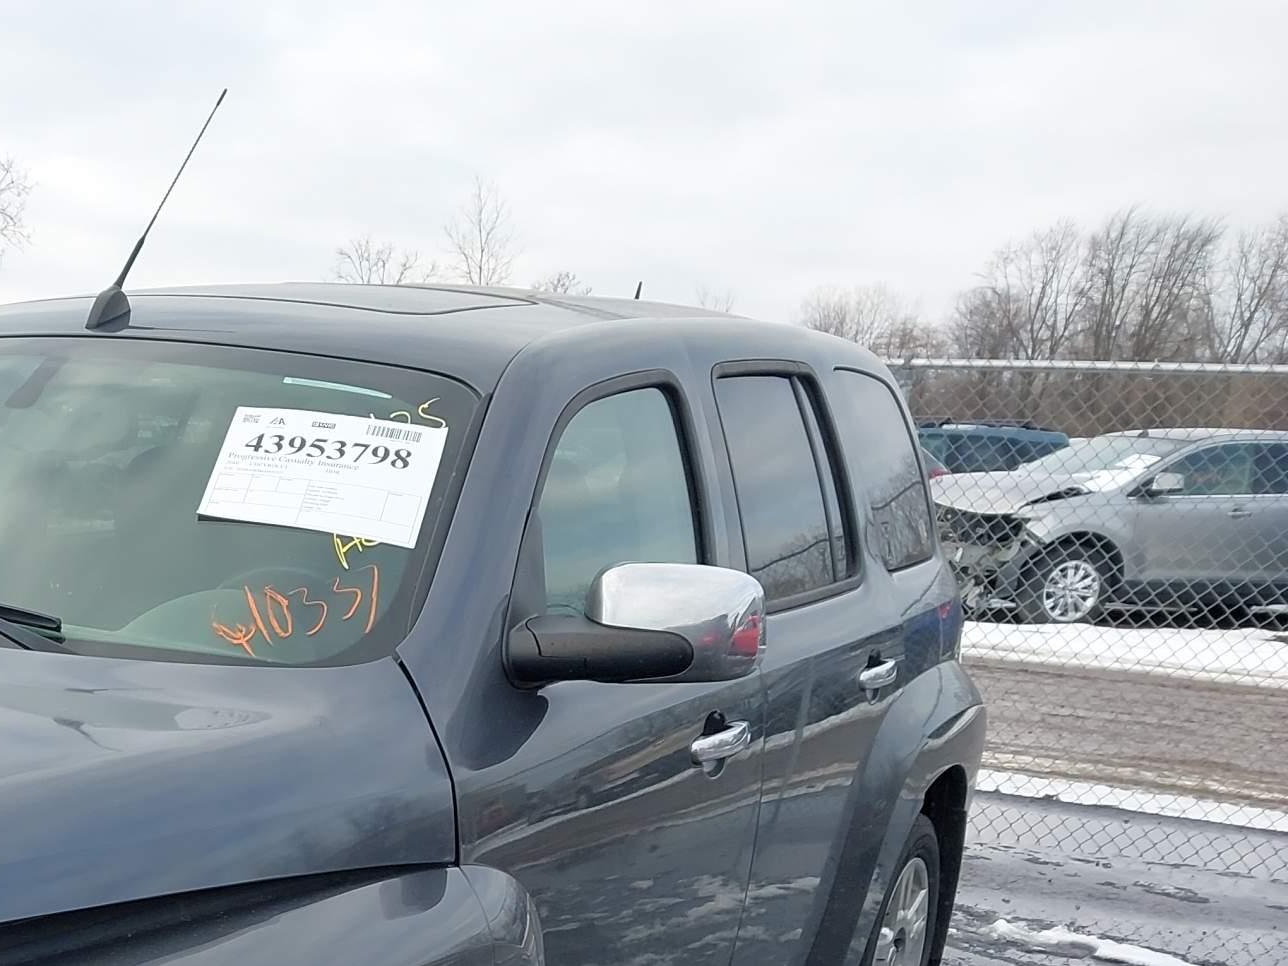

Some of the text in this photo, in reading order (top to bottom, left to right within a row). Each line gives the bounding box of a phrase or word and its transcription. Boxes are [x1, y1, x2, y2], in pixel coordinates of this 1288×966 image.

[228, 452, 276, 463] Progressive
[279, 456, 315, 466] Casualty
[317, 459, 360, 471] Insurance
[244, 433, 412, 470] 43953798
